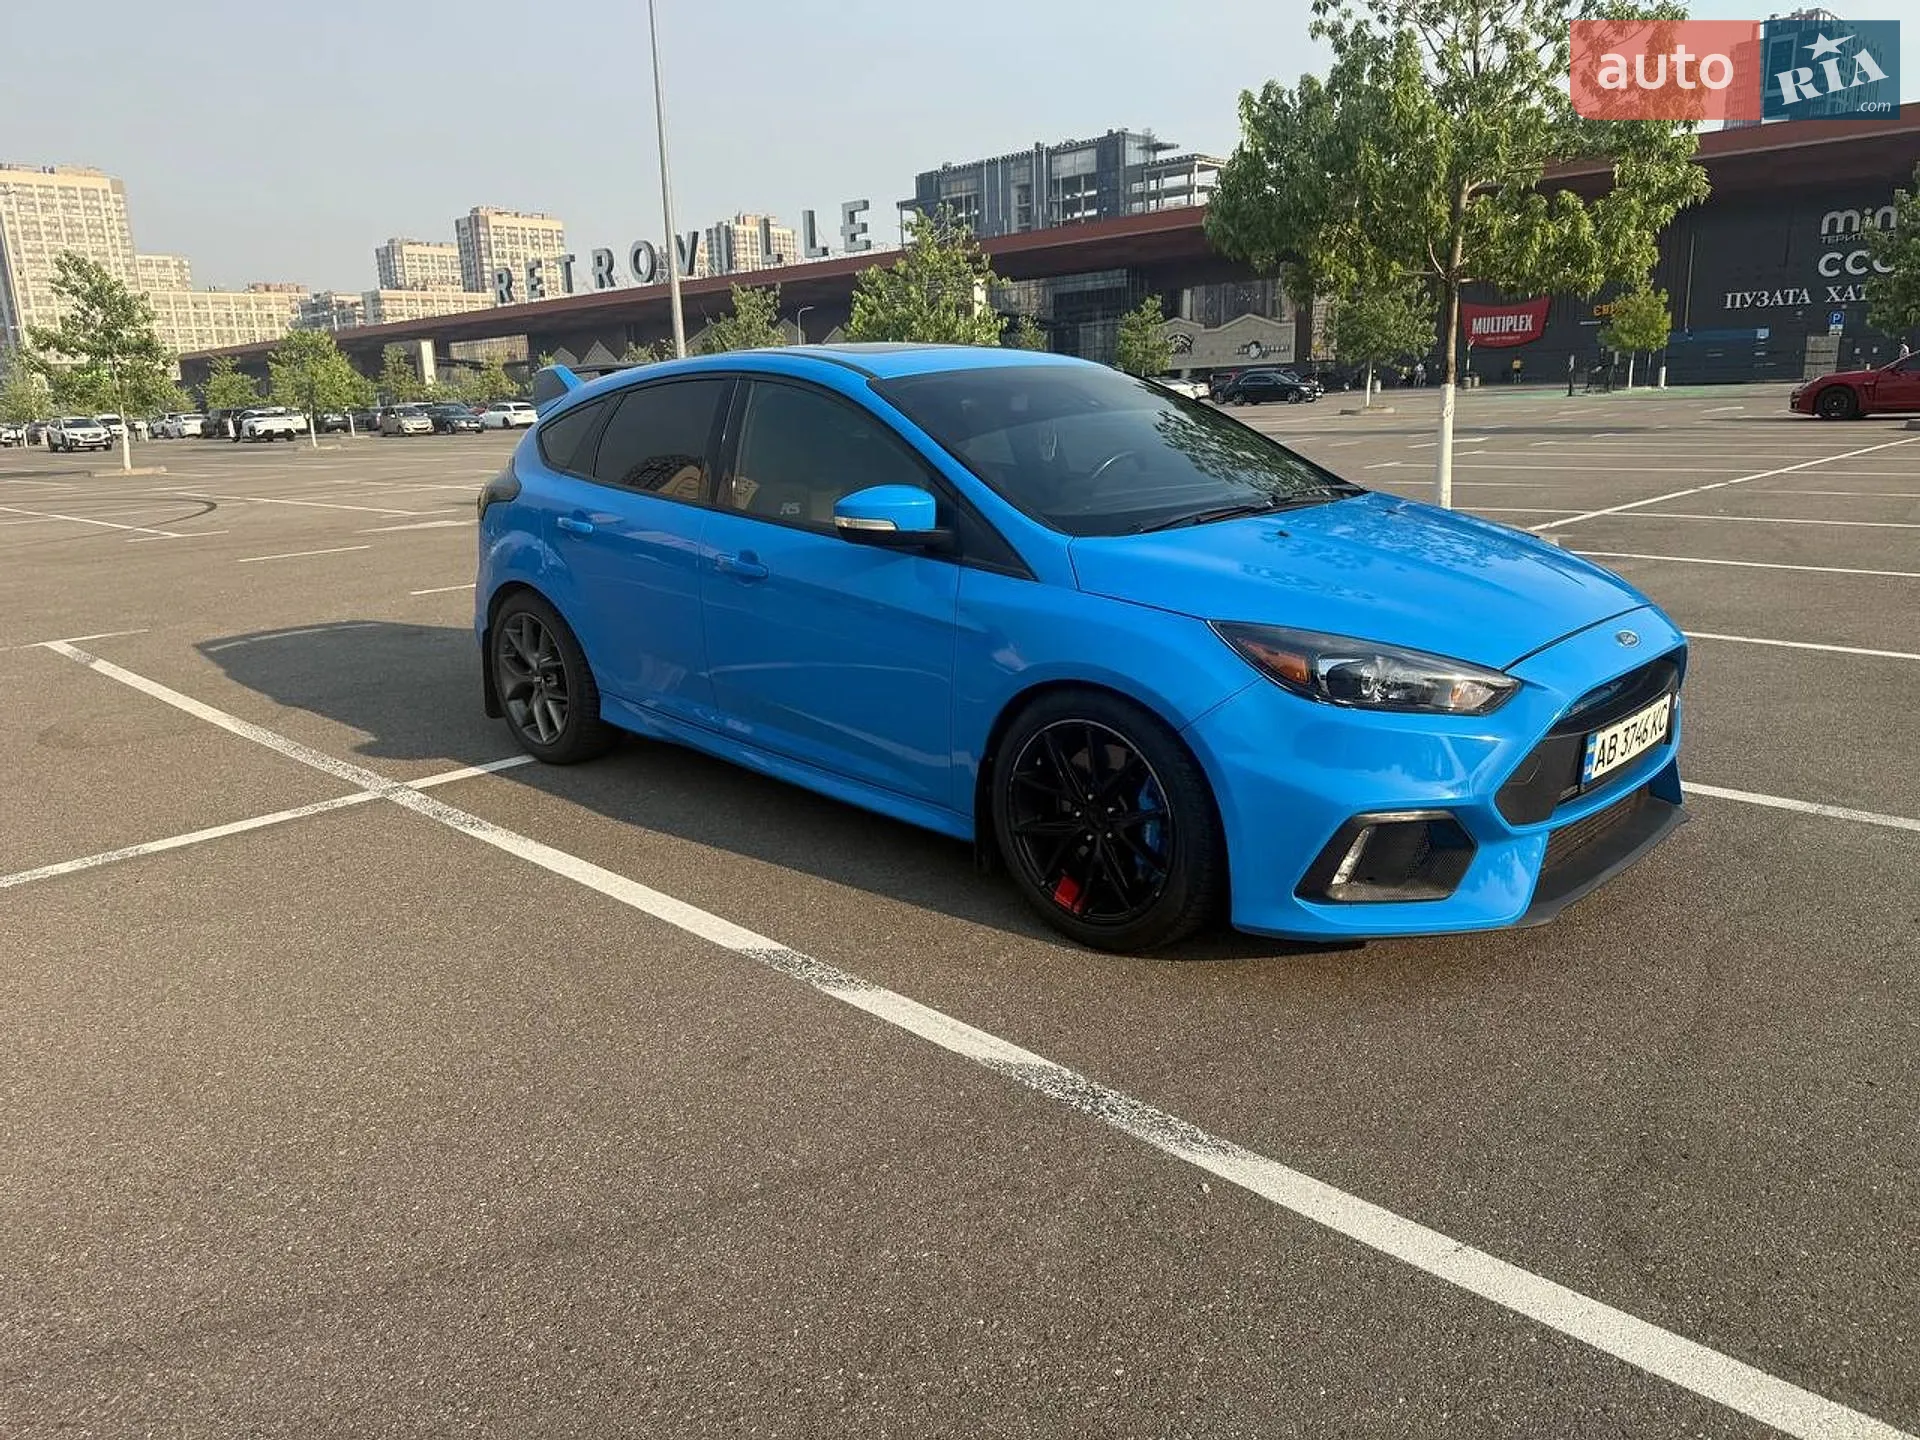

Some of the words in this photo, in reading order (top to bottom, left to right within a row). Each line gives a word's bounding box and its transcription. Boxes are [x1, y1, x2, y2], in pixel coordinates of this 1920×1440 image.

[494, 198, 872, 304] RETROVILLE
[1723, 287, 1812, 309] ПУЗАТА
[1825, 284, 1868, 303] ХАТ
[1472, 313, 1533, 335] MULTIPLEX
[1594, 733, 1618, 772] AB
[1620, 713, 1651, 757] 3746
[1650, 703, 1668, 740] KC
